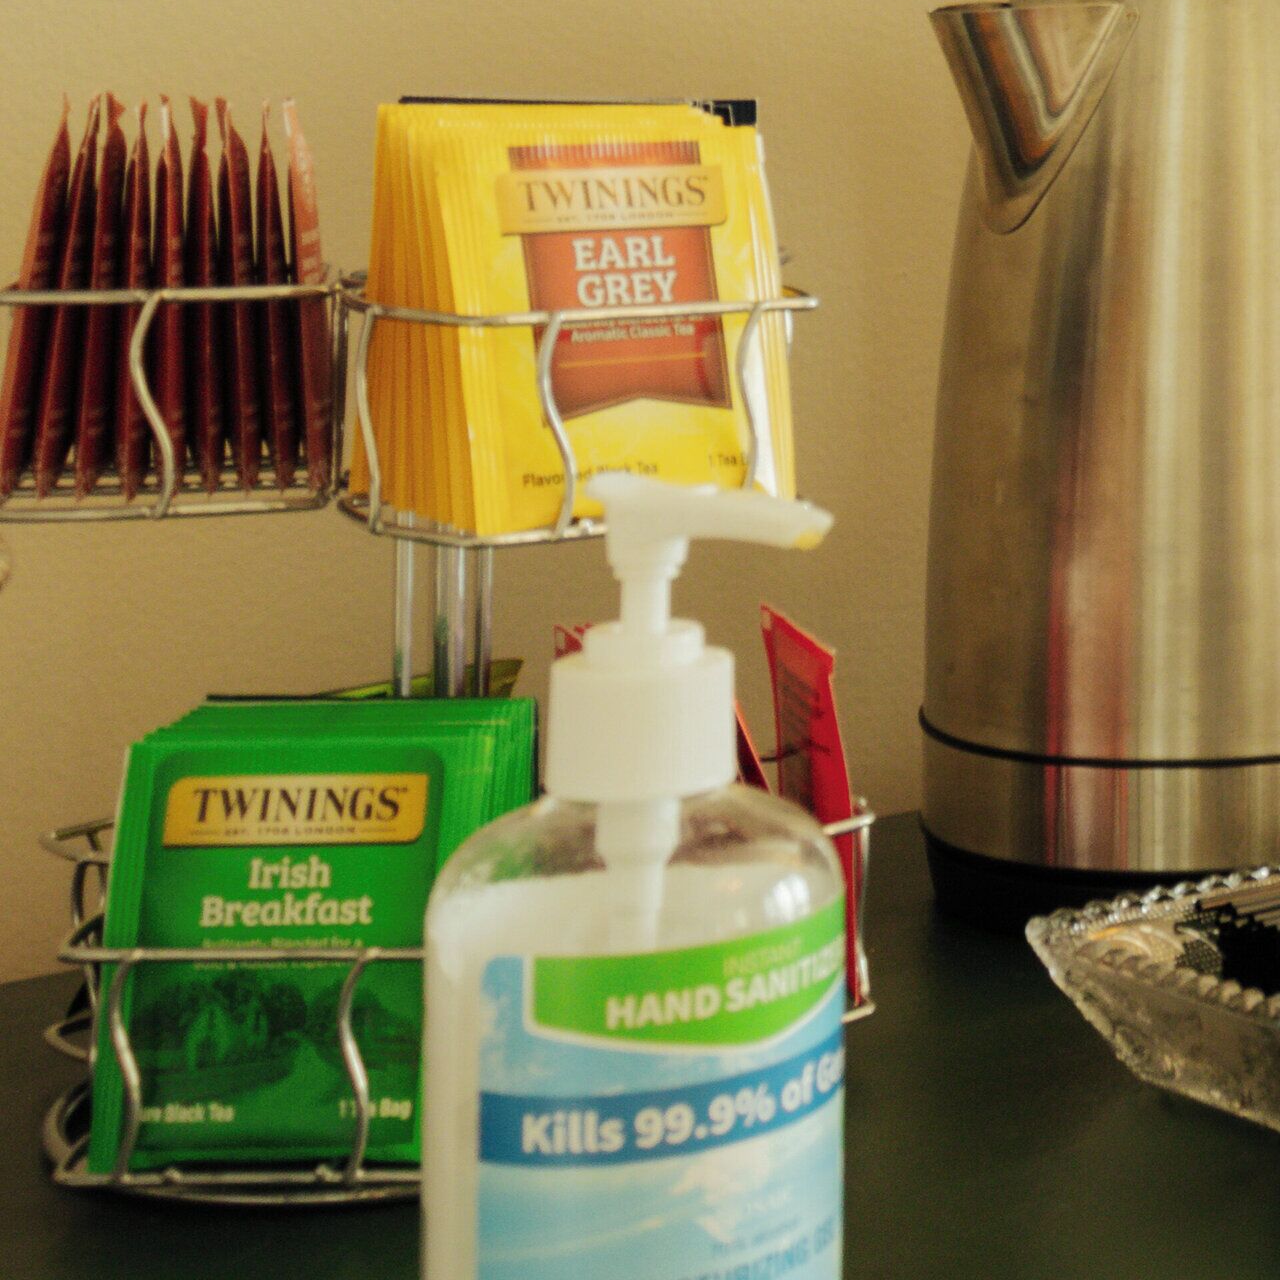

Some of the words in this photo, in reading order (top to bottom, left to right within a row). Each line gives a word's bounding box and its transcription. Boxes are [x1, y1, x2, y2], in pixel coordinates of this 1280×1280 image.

[518, 176, 707, 212] TWININGS
[572, 235, 676, 271] EARL
[576, 270, 677, 307] GREY
[673, 323, 695, 336] Tea
[193, 784, 404, 823] TWININGS
[248, 854, 331, 889] Irish
[199, 891, 373, 927] Breakfast
[605, 984, 721, 1030] HAND
[165, 1102, 203, 1123] Black
[209, 1101, 234, 1122] Tea
[380, 1096, 412, 1121] Bag
[521, 1109, 626, 1154] Kills
[634, 1084, 777, 1149] 99.9%
[781, 1061, 815, 1113] of
